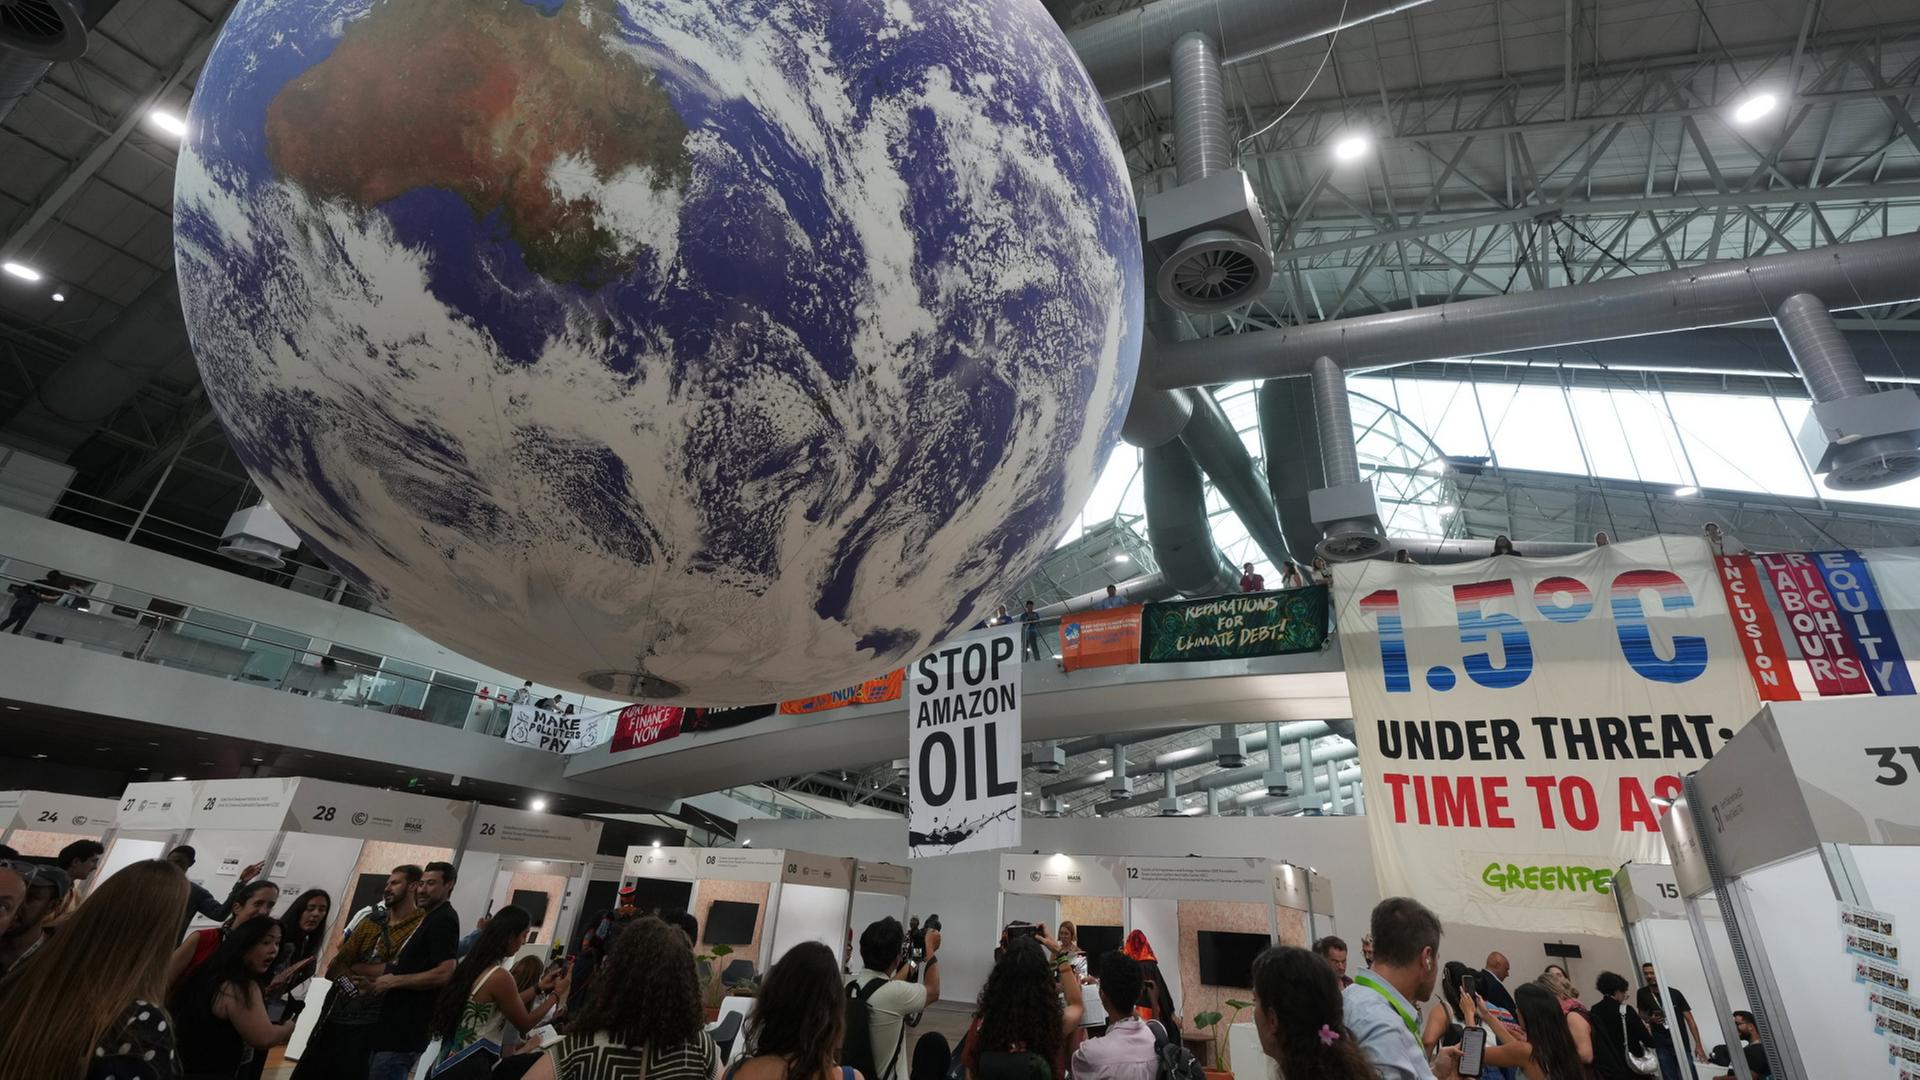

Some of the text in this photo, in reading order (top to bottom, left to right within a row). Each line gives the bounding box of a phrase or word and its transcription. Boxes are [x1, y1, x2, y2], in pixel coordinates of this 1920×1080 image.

[1185, 597, 1278, 620] REPARATIONS
[1763, 555, 1836, 680] LABOUR
[1785, 553, 1860, 679] RIGHTS
[1217, 615, 1243, 630] FOR
[1722, 557, 1779, 686] INCLUSION
[1819, 553, 1894, 692] EQUITY
[1176, 619, 1286, 651] CLIMATE DEBT!
[916, 636, 1014, 696] STOP
[916, 683, 1016, 729] AMAZON
[534, 710, 581, 731] MAKE
[628, 708, 671, 731] FINANCE
[528, 722, 581, 740] POLLUTERS
[632, 724, 662, 745] NOW
[1377, 719, 1525, 761] UNDER
[539, 736, 570, 753] PAY
[918, 722, 1018, 807] OIL
[123, 799, 136, 812] 27
[312, 805, 337, 821] 28
[1383, 773, 1516, 829] TIME
[1525, 775, 1601, 832] TO
[37, 811, 59, 823] 24
[480, 823, 496, 836] 26
[633, 855, 643, 864] 07
[1006, 869, 1016, 881] 11
[1126, 867, 1139, 879] 12
[1656, 883, 1679, 899] 15
